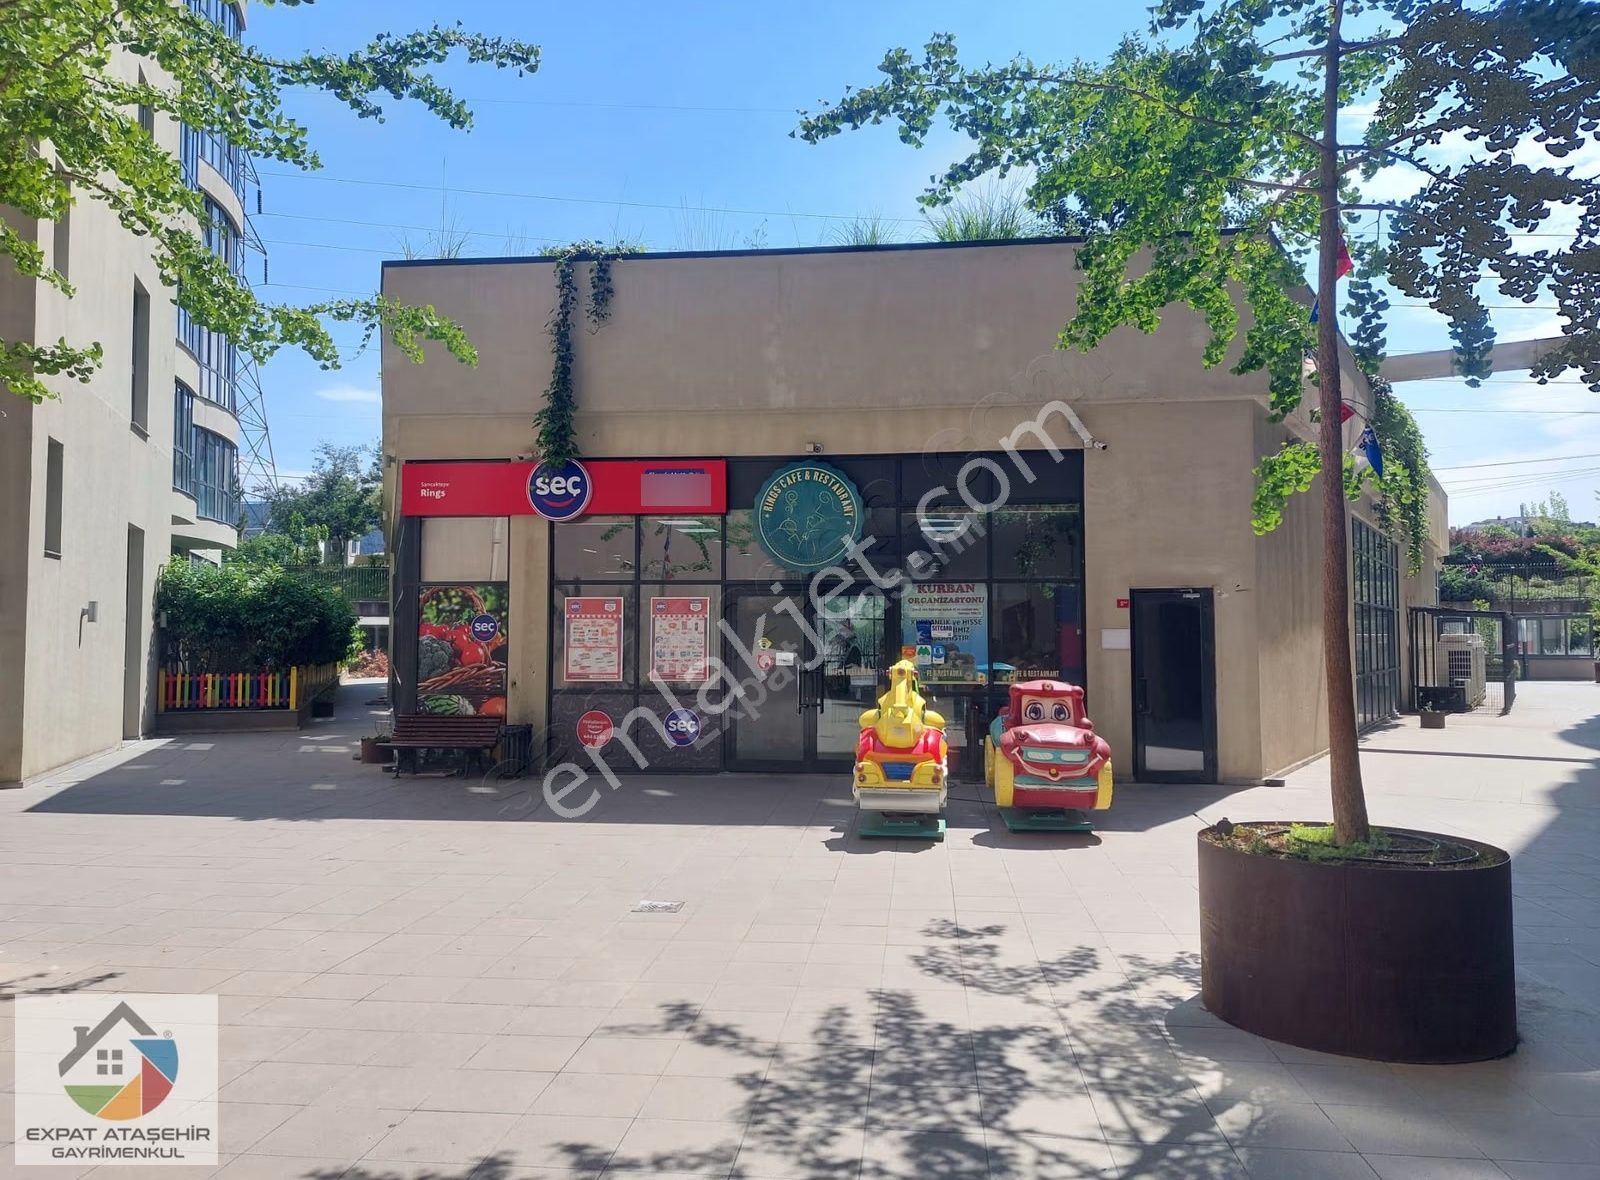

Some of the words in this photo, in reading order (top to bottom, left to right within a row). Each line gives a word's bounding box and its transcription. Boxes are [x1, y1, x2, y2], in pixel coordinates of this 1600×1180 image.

[535, 475, 582, 497] seç
[420, 488, 446, 499] Rings
[763, 485, 782, 512] RINGS
[779, 472, 803, 488] CAFE
[804, 470, 811, 480] &
[812, 470, 854, 517] RESTAURANT
[917, 584, 976, 594] KURBAN
[474, 622, 495, 634] seç
